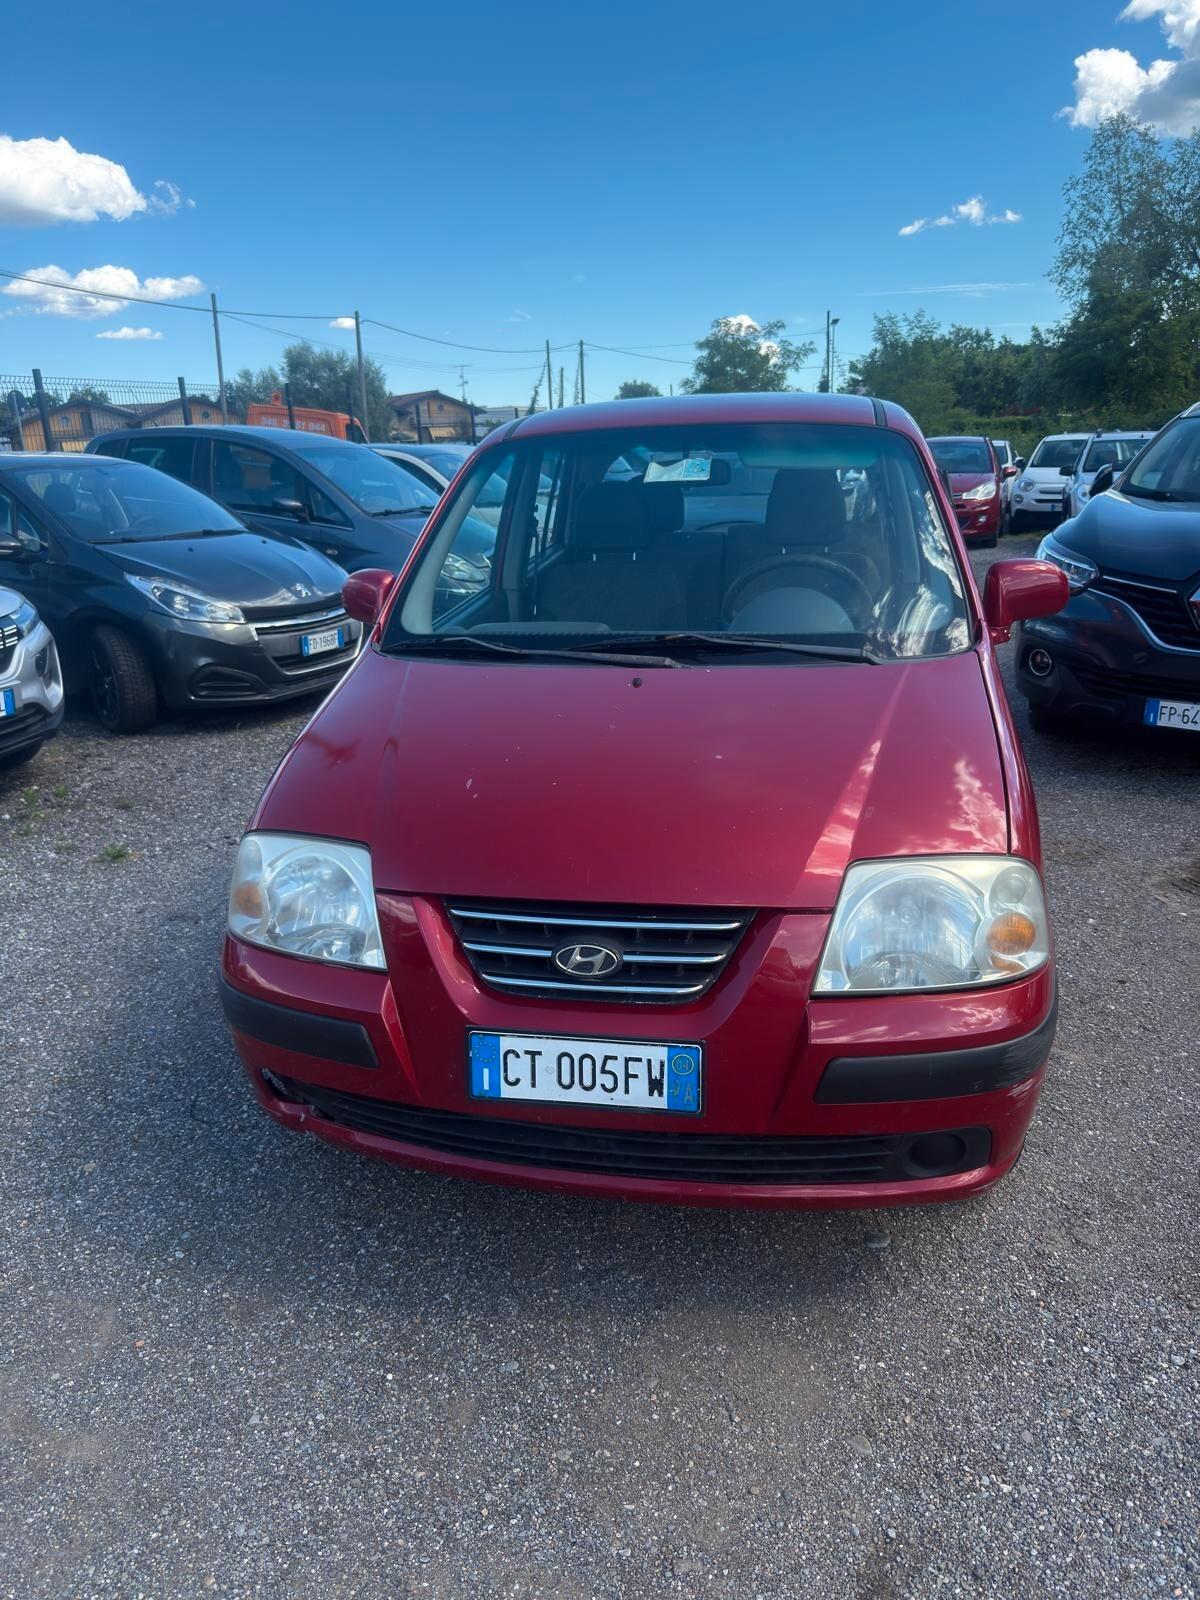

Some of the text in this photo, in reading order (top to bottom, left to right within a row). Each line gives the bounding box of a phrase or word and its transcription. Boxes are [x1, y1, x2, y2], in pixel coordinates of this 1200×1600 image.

[1159, 705, 1178, 722] FP
[503, 1049, 665, 1098] CT 005FW
